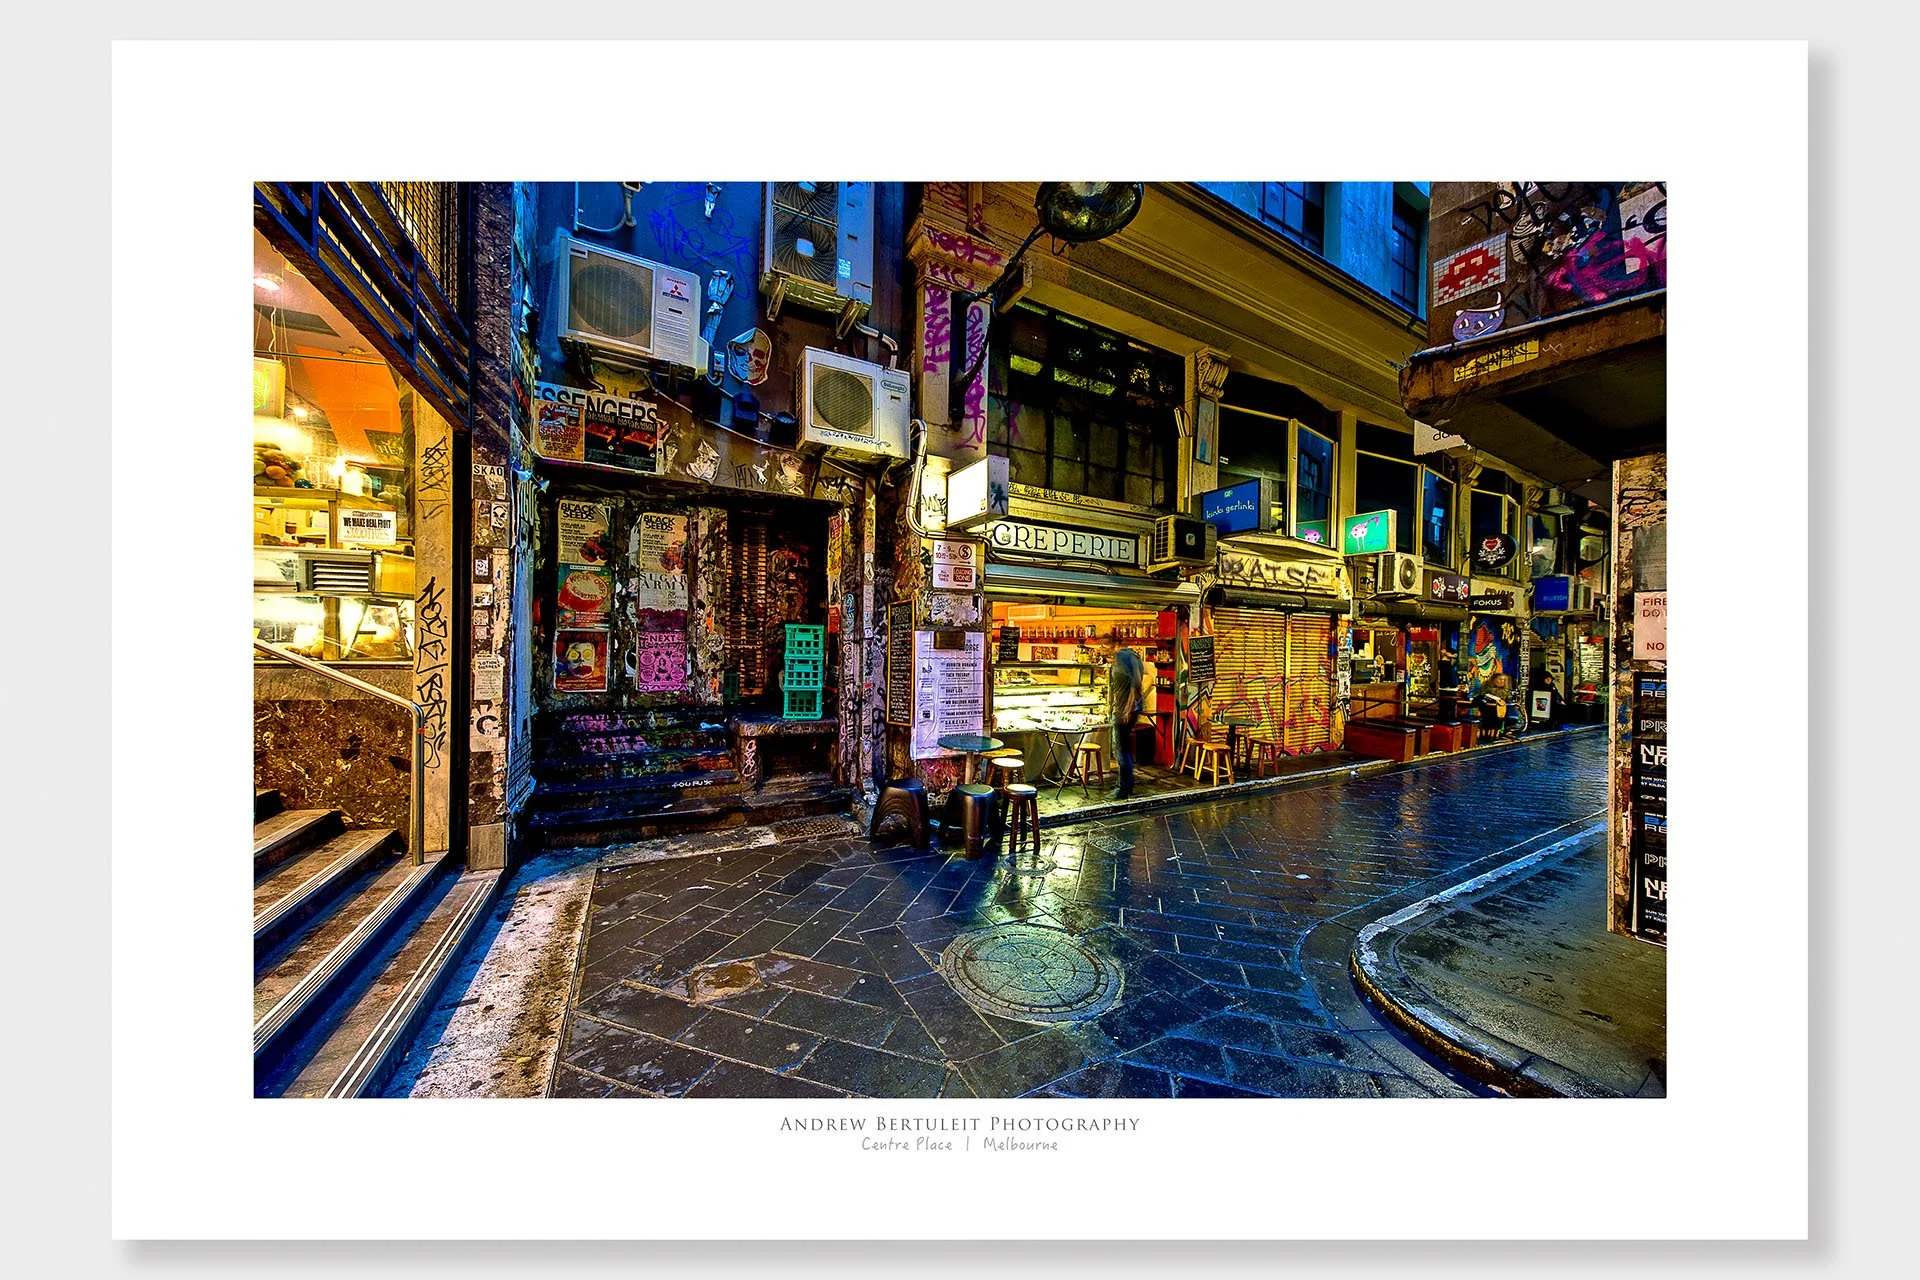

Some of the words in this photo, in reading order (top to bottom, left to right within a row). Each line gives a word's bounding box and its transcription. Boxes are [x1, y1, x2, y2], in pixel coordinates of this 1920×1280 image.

[561, 502, 597, 514] BLACK
[562, 511, 595, 521] SEEDS
[643, 515, 676, 526] BLACK
[343, 517, 351, 527] WE
[352, 518, 365, 528] MAKE
[366, 518, 377, 528] REAL
[377, 519, 391, 529] FRUIT
[645, 522, 674, 532] SEEDS
[993, 523, 1131, 560] CREPERIE
[640, 573, 687, 583] SUGAR
[640, 581, 687, 590] ARMY
[1643, 609, 1660, 618] DO
[1646, 642, 1665, 651] NO
